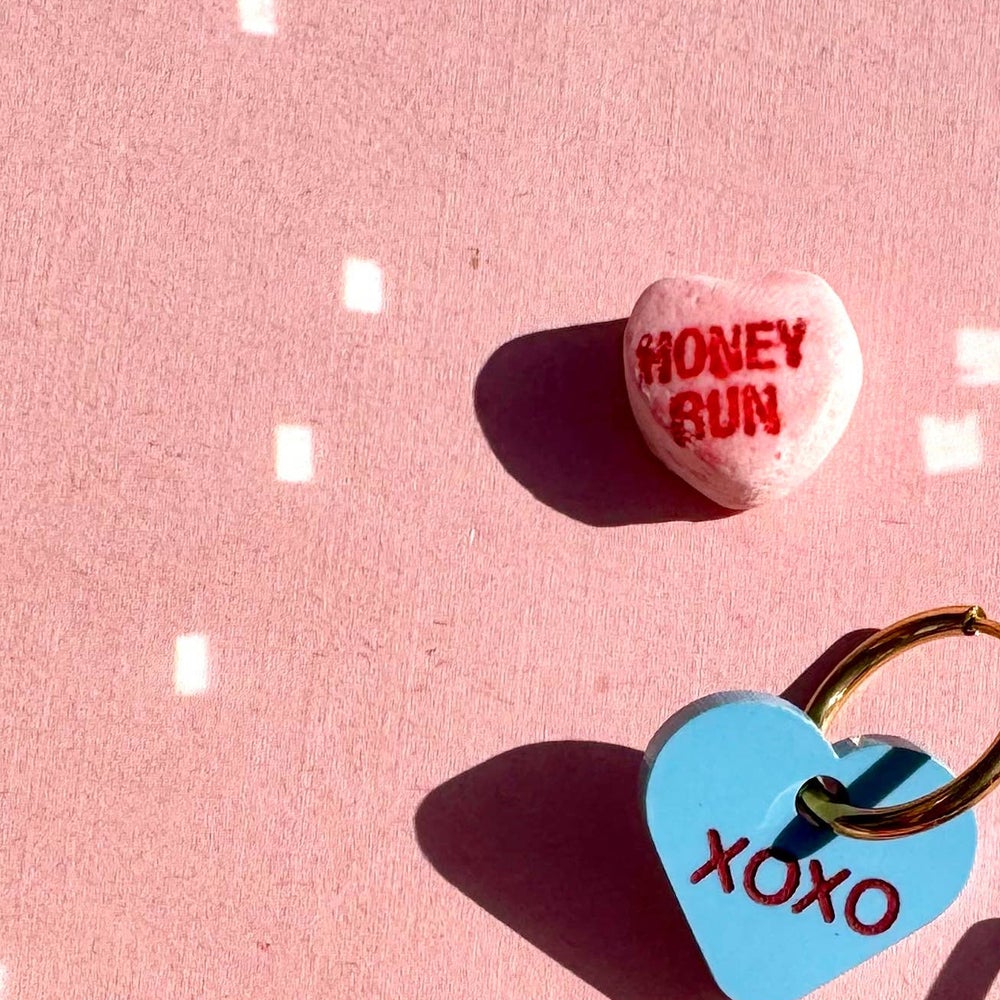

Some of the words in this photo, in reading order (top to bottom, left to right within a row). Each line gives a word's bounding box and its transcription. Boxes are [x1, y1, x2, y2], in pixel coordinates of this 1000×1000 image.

[636, 317, 807, 385] HONEY
[669, 383, 781, 447] BUN
[690, 829, 900, 936] XOXO
